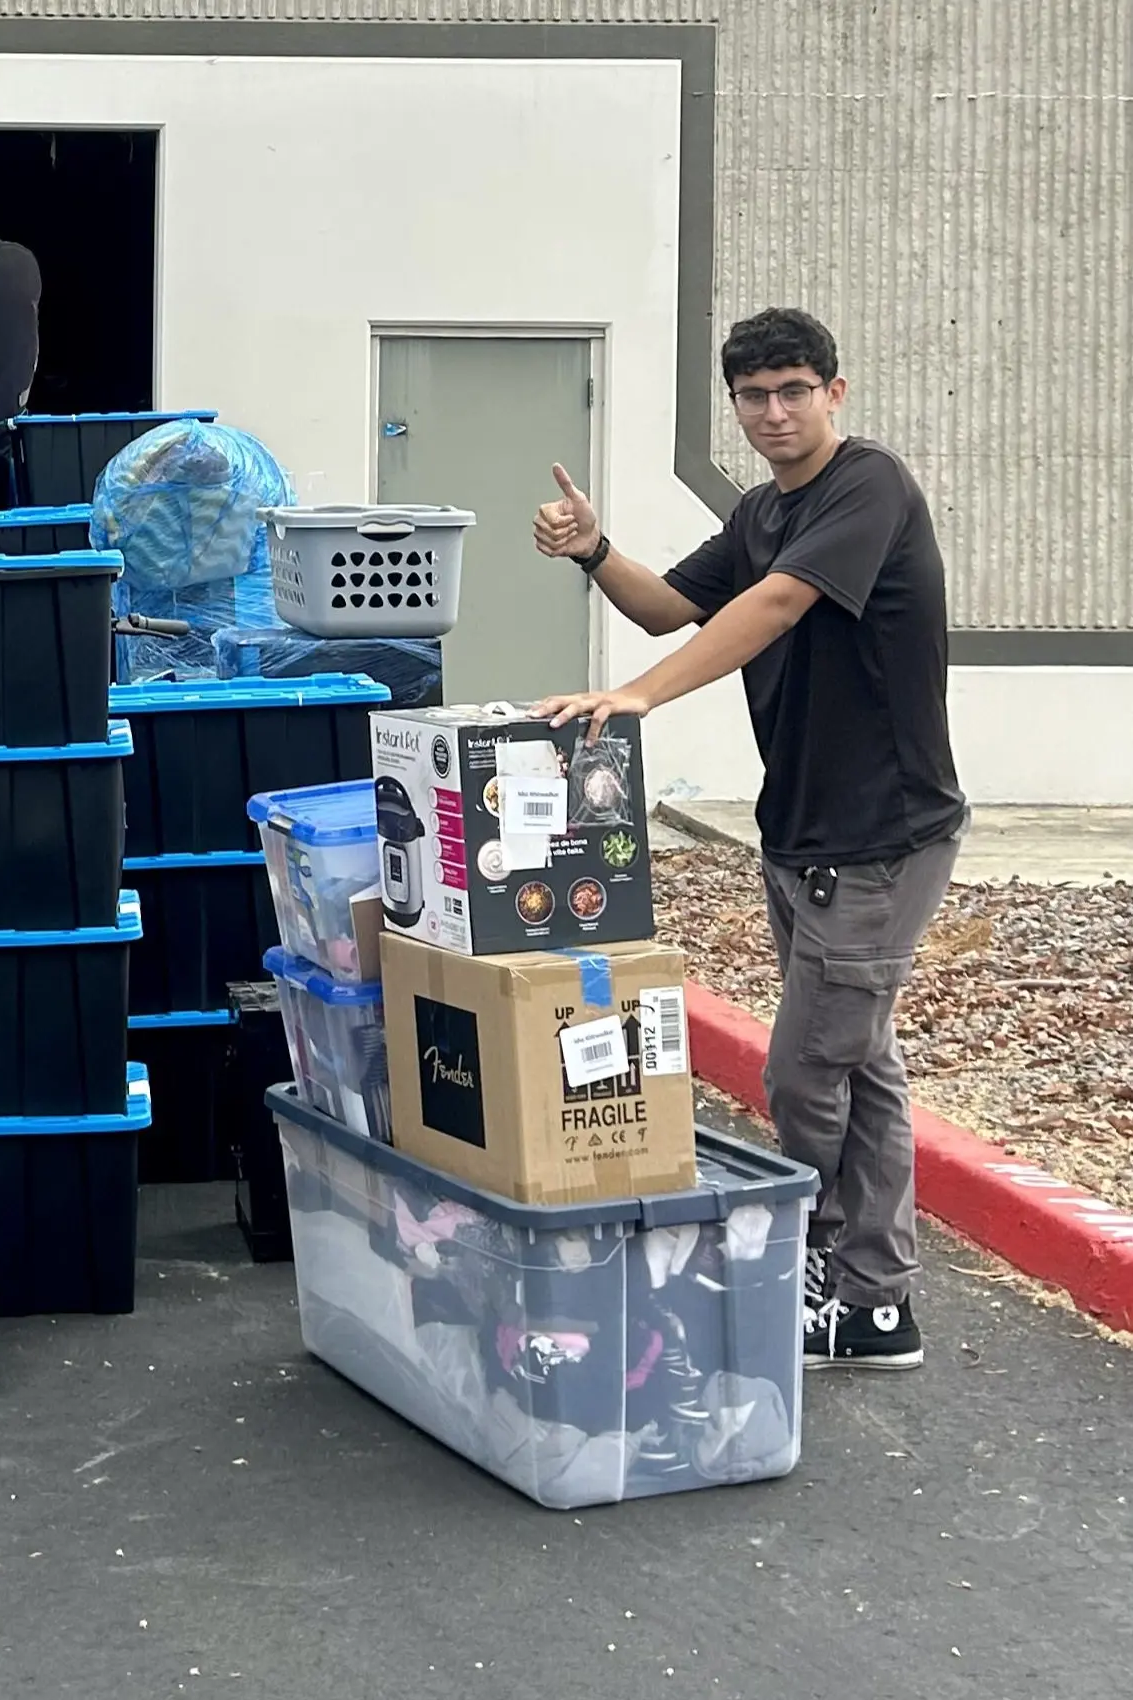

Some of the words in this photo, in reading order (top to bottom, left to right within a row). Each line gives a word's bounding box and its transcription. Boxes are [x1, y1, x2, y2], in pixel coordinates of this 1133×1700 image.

[555, 1007, 574, 1020] UP
[621, 1000, 640, 1013] UP
[423, 1045, 475, 1088] Fender
[561, 1100, 647, 1132] FRAGILE
